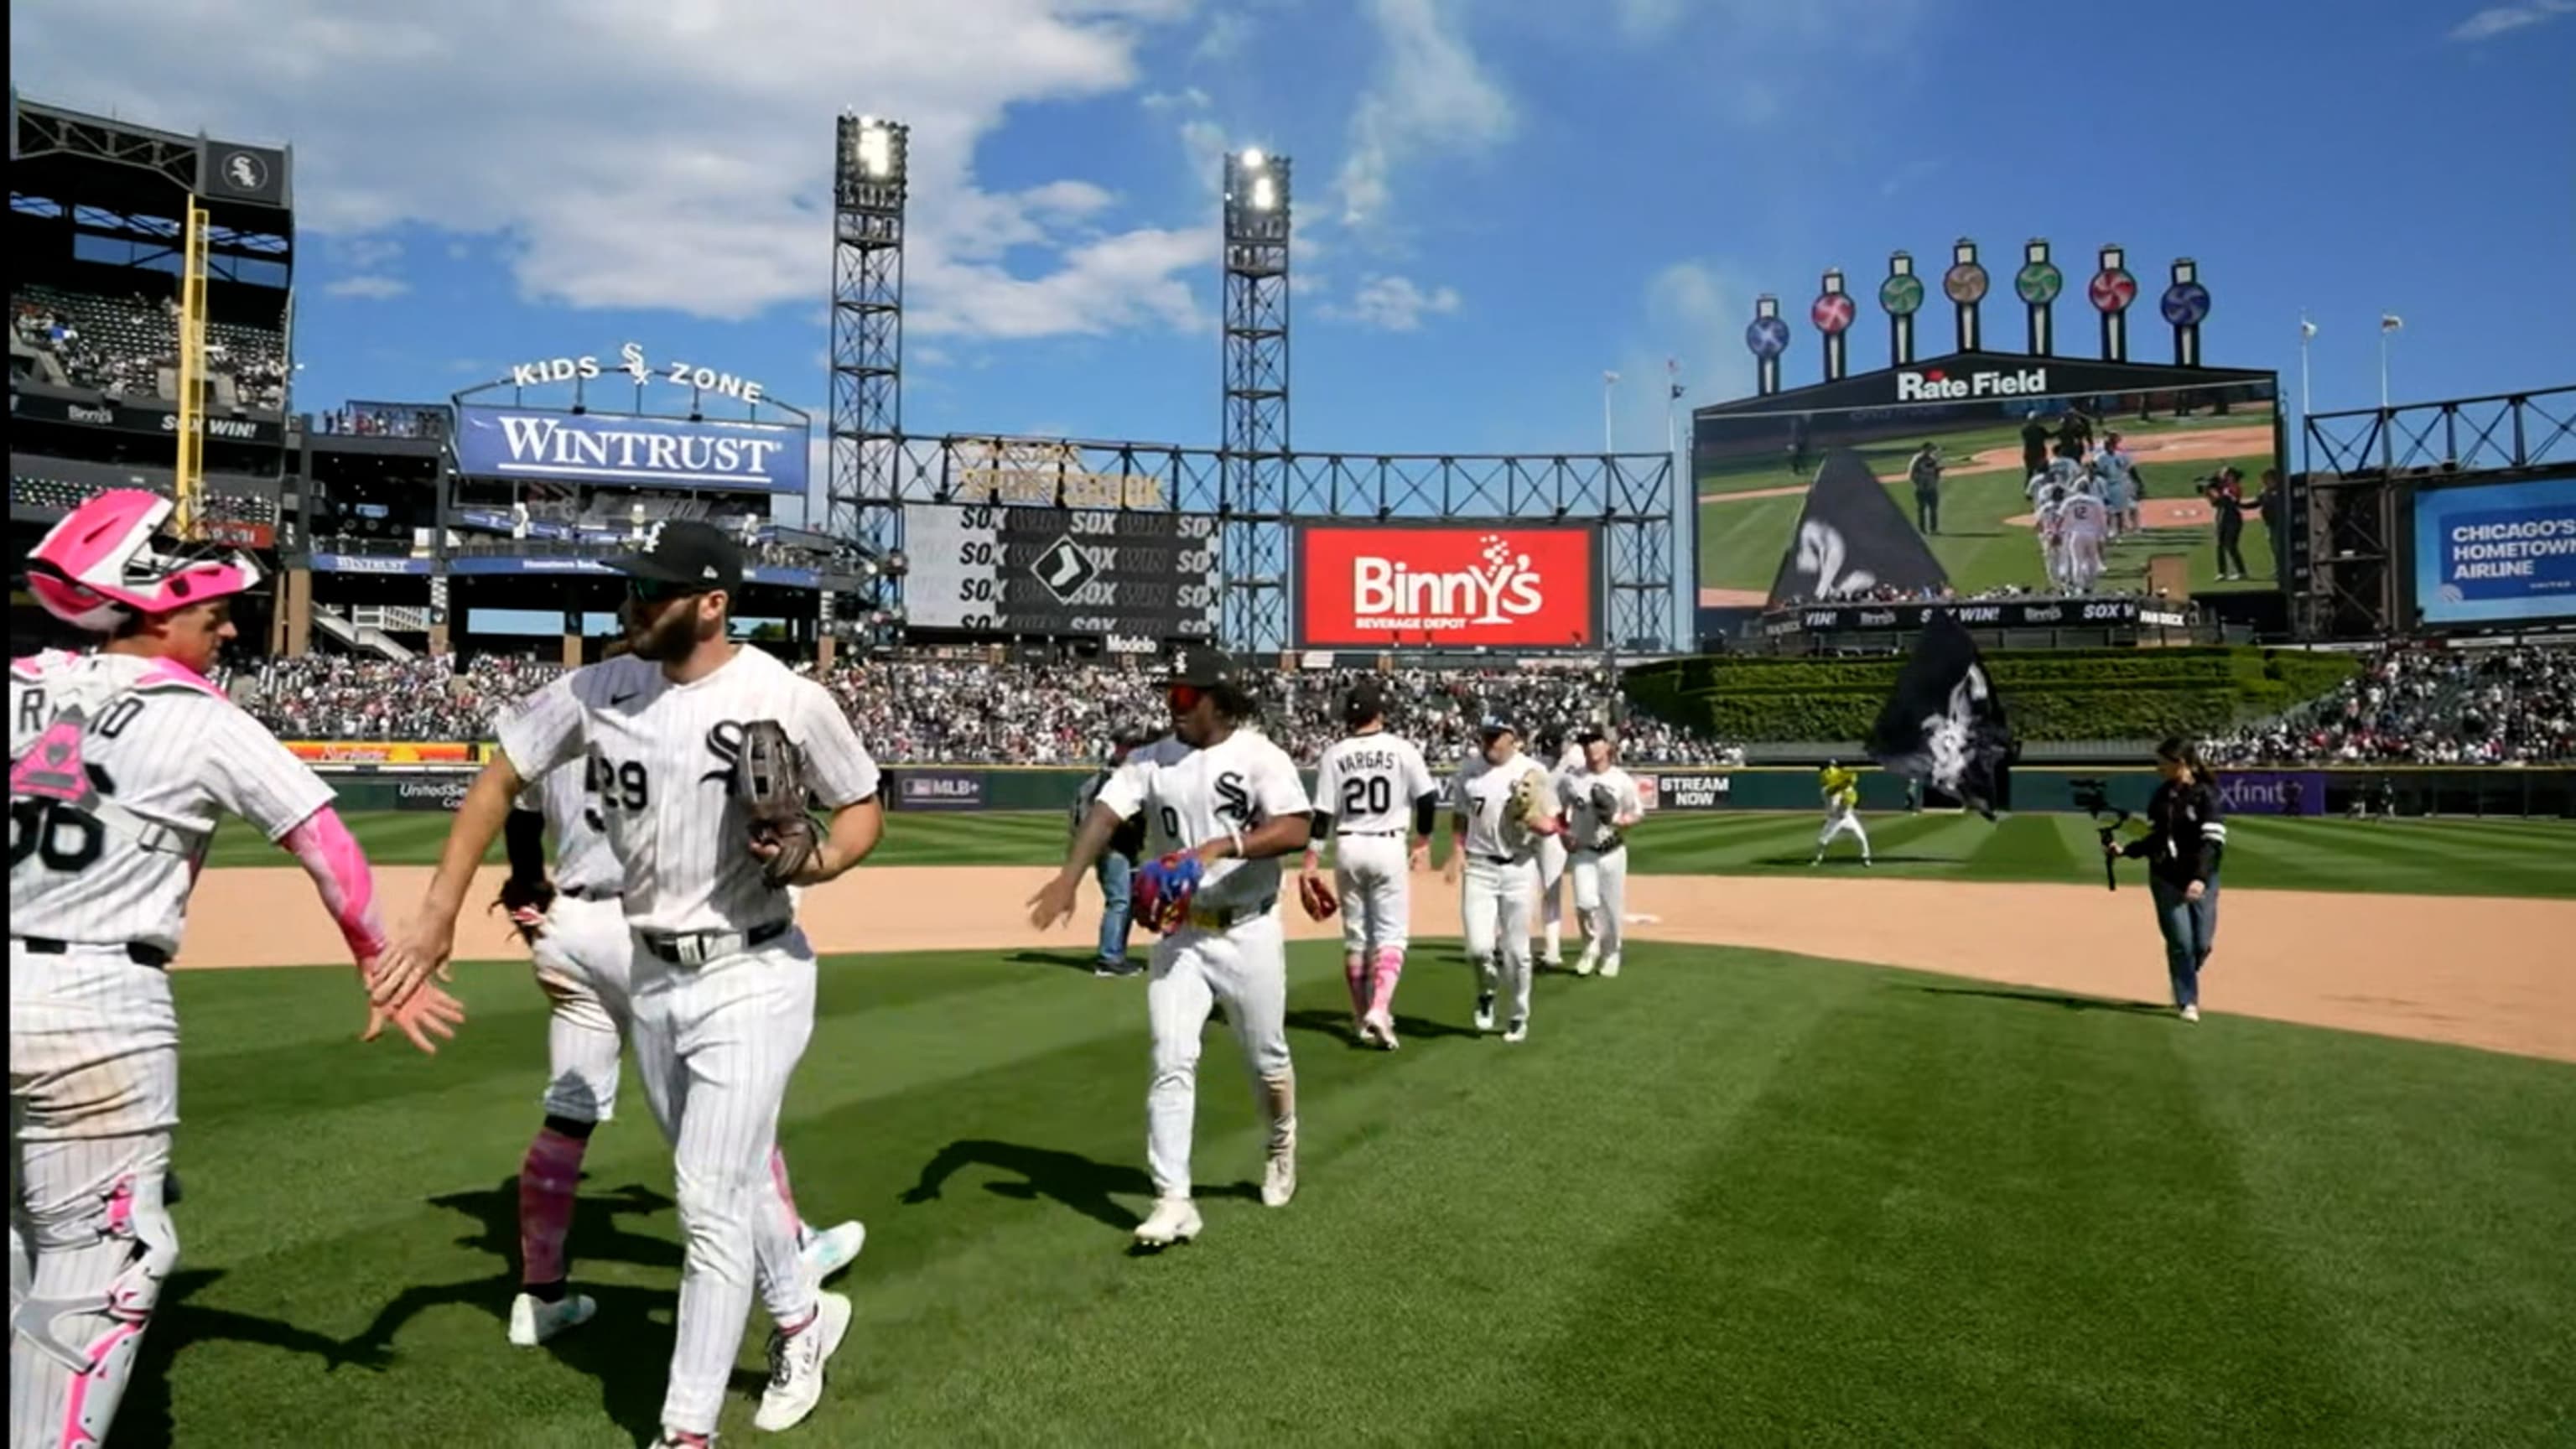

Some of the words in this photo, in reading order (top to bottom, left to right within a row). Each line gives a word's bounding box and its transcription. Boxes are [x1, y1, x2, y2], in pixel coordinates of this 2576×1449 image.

[513, 356, 600, 387] KIDS
[669, 361, 763, 403] ZONE
[1898, 371, 1969, 401] Rate
[1972, 369, 2046, 396] Field
[209, 419, 257, 439] WIN!
[961, 506, 1009, 530] SOX
[1070, 512, 1117, 535] SOX
[1176, 516, 1221, 538] SOX
[2453, 519, 2576, 542] CHICAGO'S
[959, 542, 1009, 566] SOX
[1080, 546, 1118, 570] OX
[1176, 549, 1221, 574] SOX
[2454, 560, 2535, 579] AIRLINE
[959, 578, 1009, 602] SOX
[1176, 585, 1221, 608] SOX
[1960, 607, 2001, 622] WIN!
[2084, 604, 2120, 619] SOX
[1355, 618, 1421, 629] BEVERAGE
[1424, 618, 1467, 629] DEPOT
[1106, 634, 1157, 654] Modelo
[1338, 750, 1394, 774] VARGAS
[1660, 776, 1729, 792] STREAM
[1343, 776, 1390, 815] 20
[1675, 792, 1716, 806] NOW
